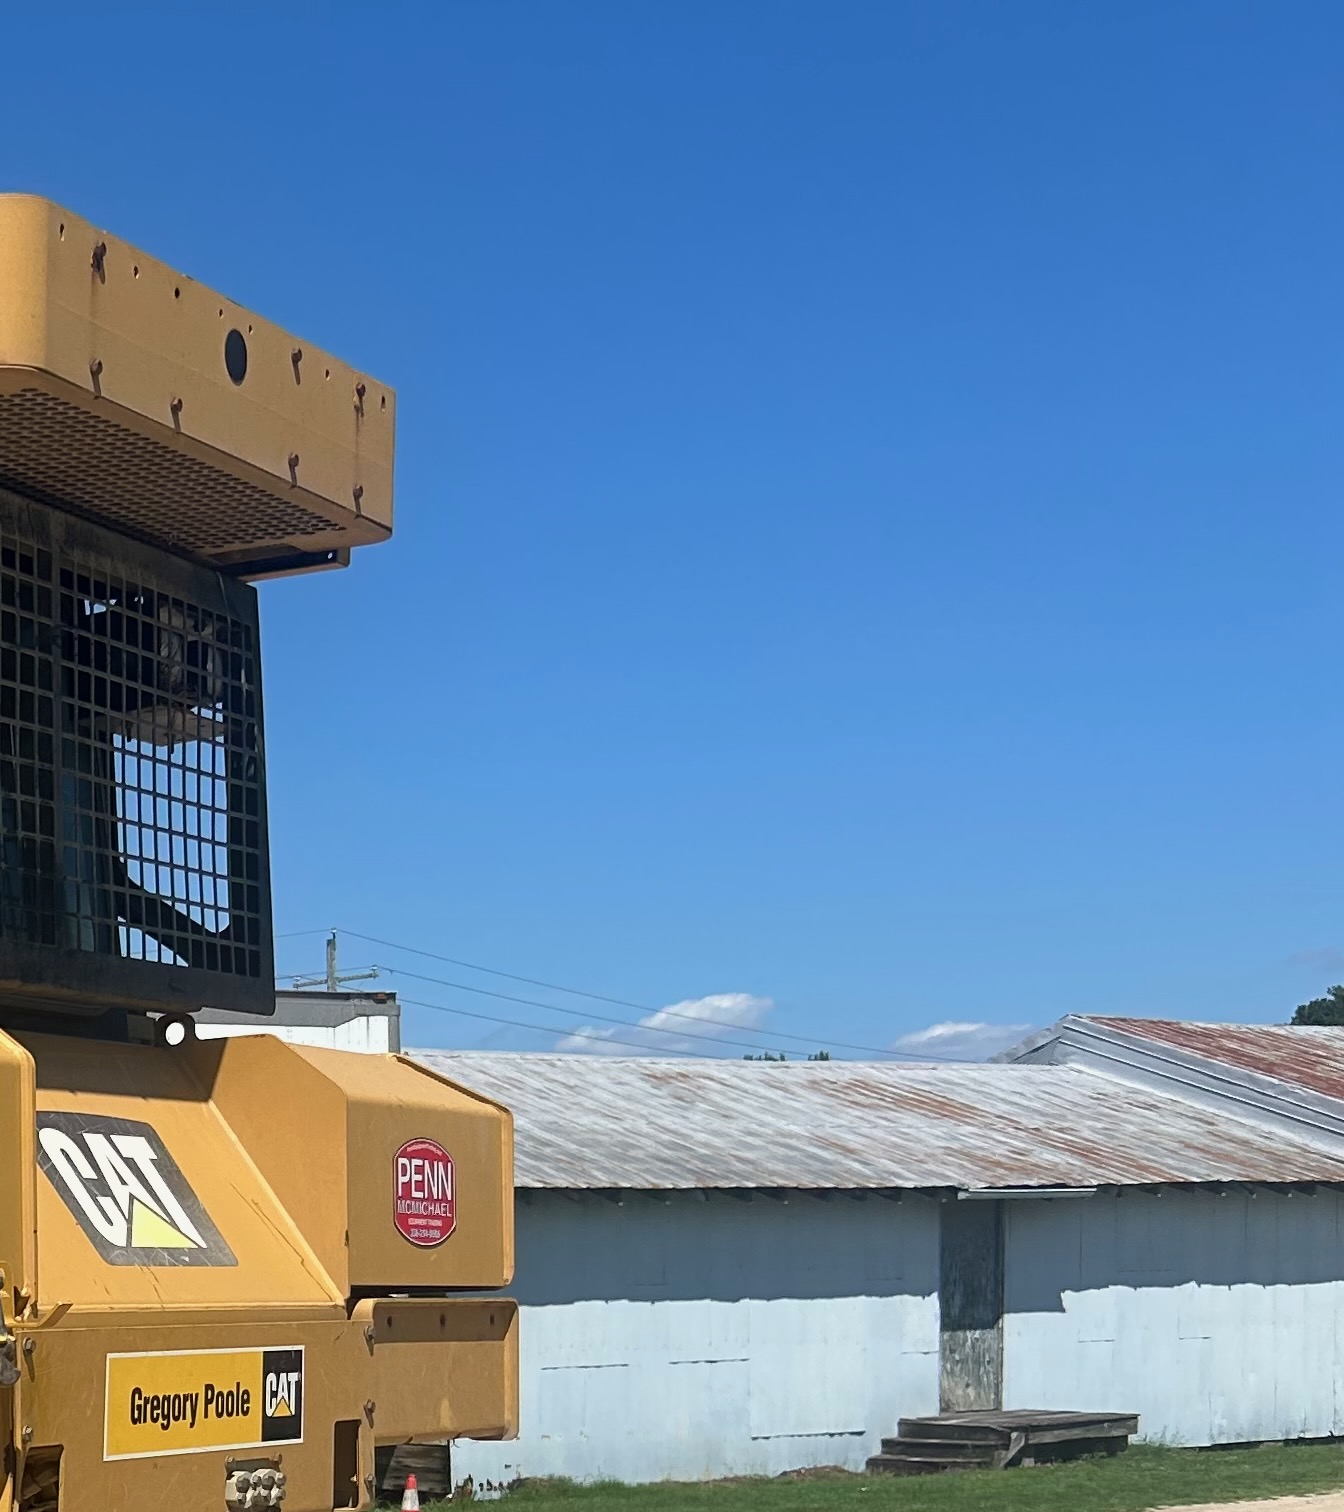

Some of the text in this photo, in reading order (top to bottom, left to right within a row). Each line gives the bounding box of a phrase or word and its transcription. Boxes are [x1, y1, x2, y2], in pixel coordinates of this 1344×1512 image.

[38, 1127, 208, 1249] CAT
[397, 1157, 452, 1201] PENN
[397, 1200, 453, 1218] MCMICHAEL
[129, 1381, 251, 1431] Gregory Poole
[265, 1371, 299, 1418] CAT
